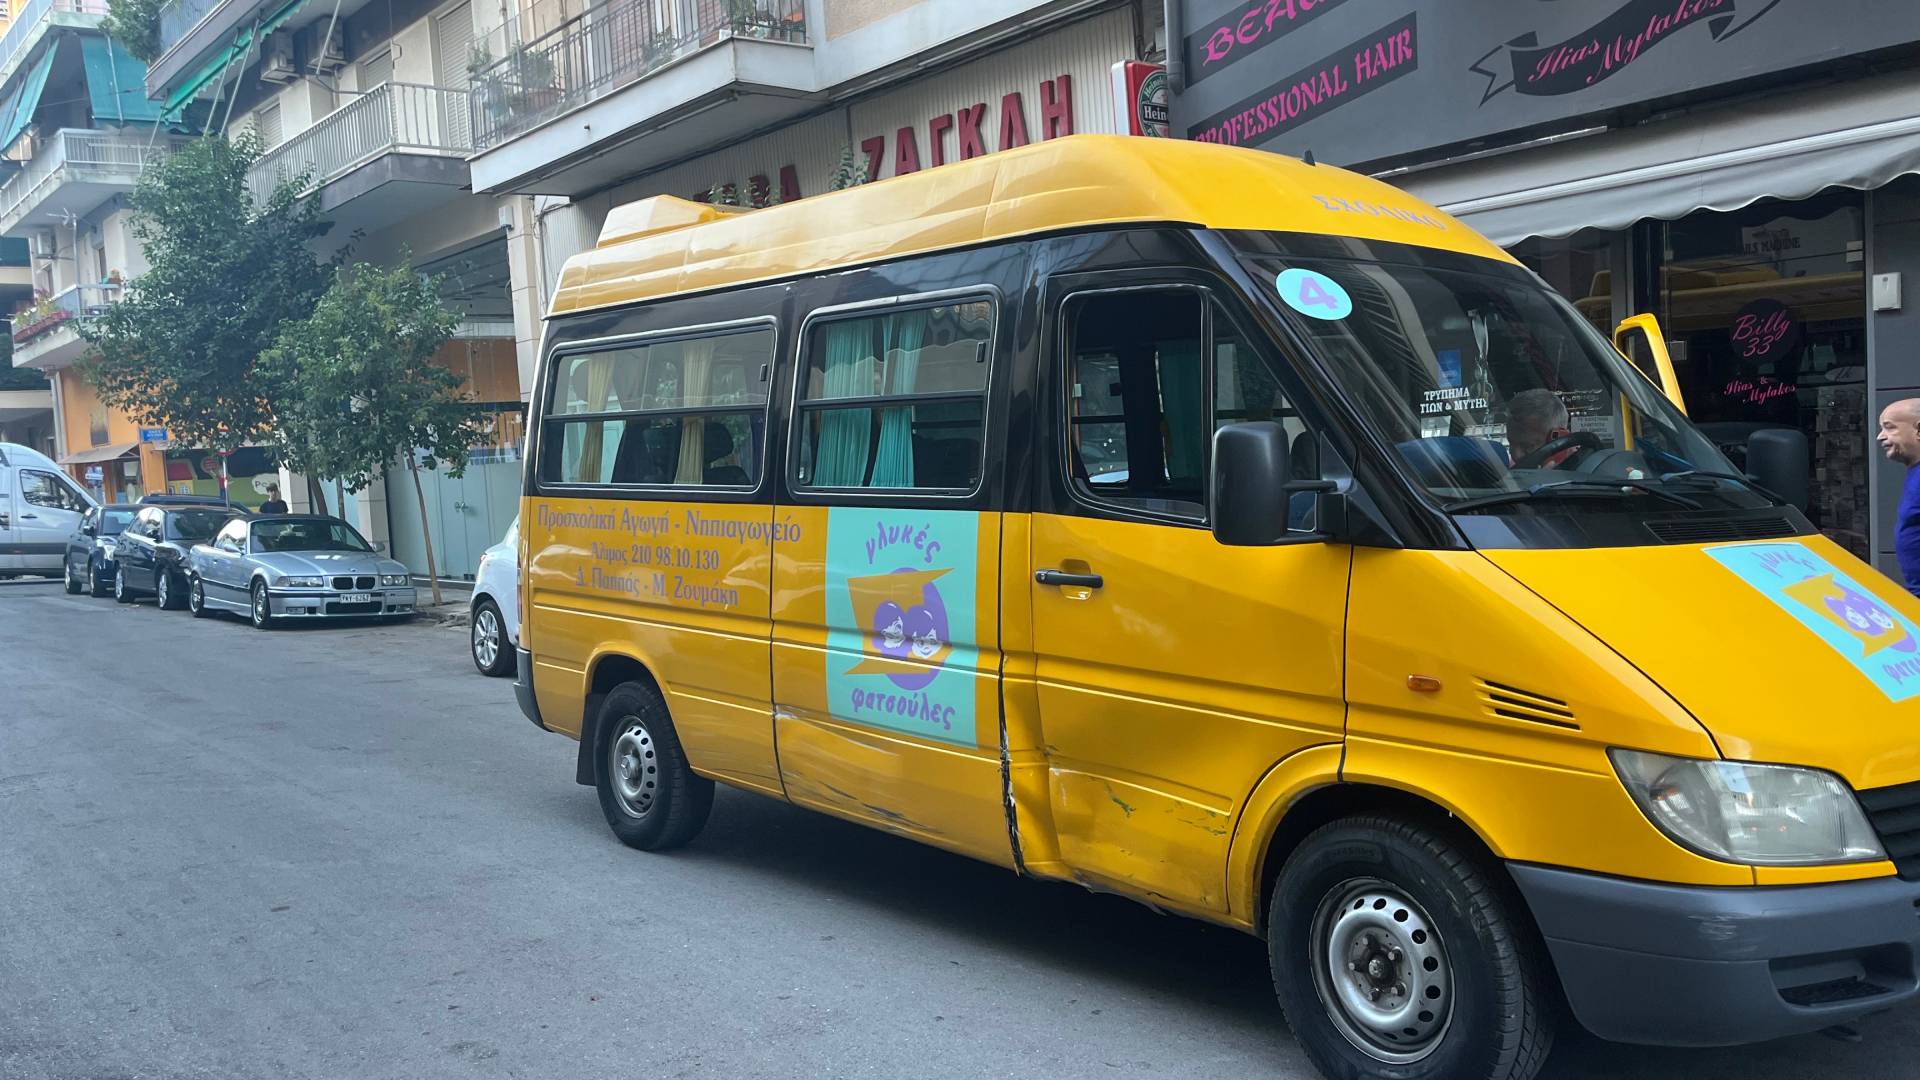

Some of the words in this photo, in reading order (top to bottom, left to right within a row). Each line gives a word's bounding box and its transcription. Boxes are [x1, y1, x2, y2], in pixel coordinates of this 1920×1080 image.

[1200, 0, 1325, 66] BEA
[1528, 39, 1600, 82] Ilias
[1193, 64, 1348, 146] ROFESSIONAL
[1355, 28, 1413, 84] HAIR
[1144, 105, 1168, 120] Hein
[1299, 277, 1338, 309] 4
[1732, 310, 1791, 342] Billy
[1743, 335, 1775, 358] 33
[1424, 386, 1470, 401] ΤΡΥΠΗΜΑ
[537, 504, 616, 532] Προσχολική
[620, 507, 670, 539] Αγωγή
[685, 509, 801, 545] Νηπιαγωγείο
[631, 544, 650, 564] 210
[656, 546, 720, 570] 98.10.130
[865, 521, 941, 565] γλυκές
[652, 573, 668, 597] Μ.
[674, 575, 738, 608] Ζουμάκη
[852, 687, 956, 730] φατσούλες
